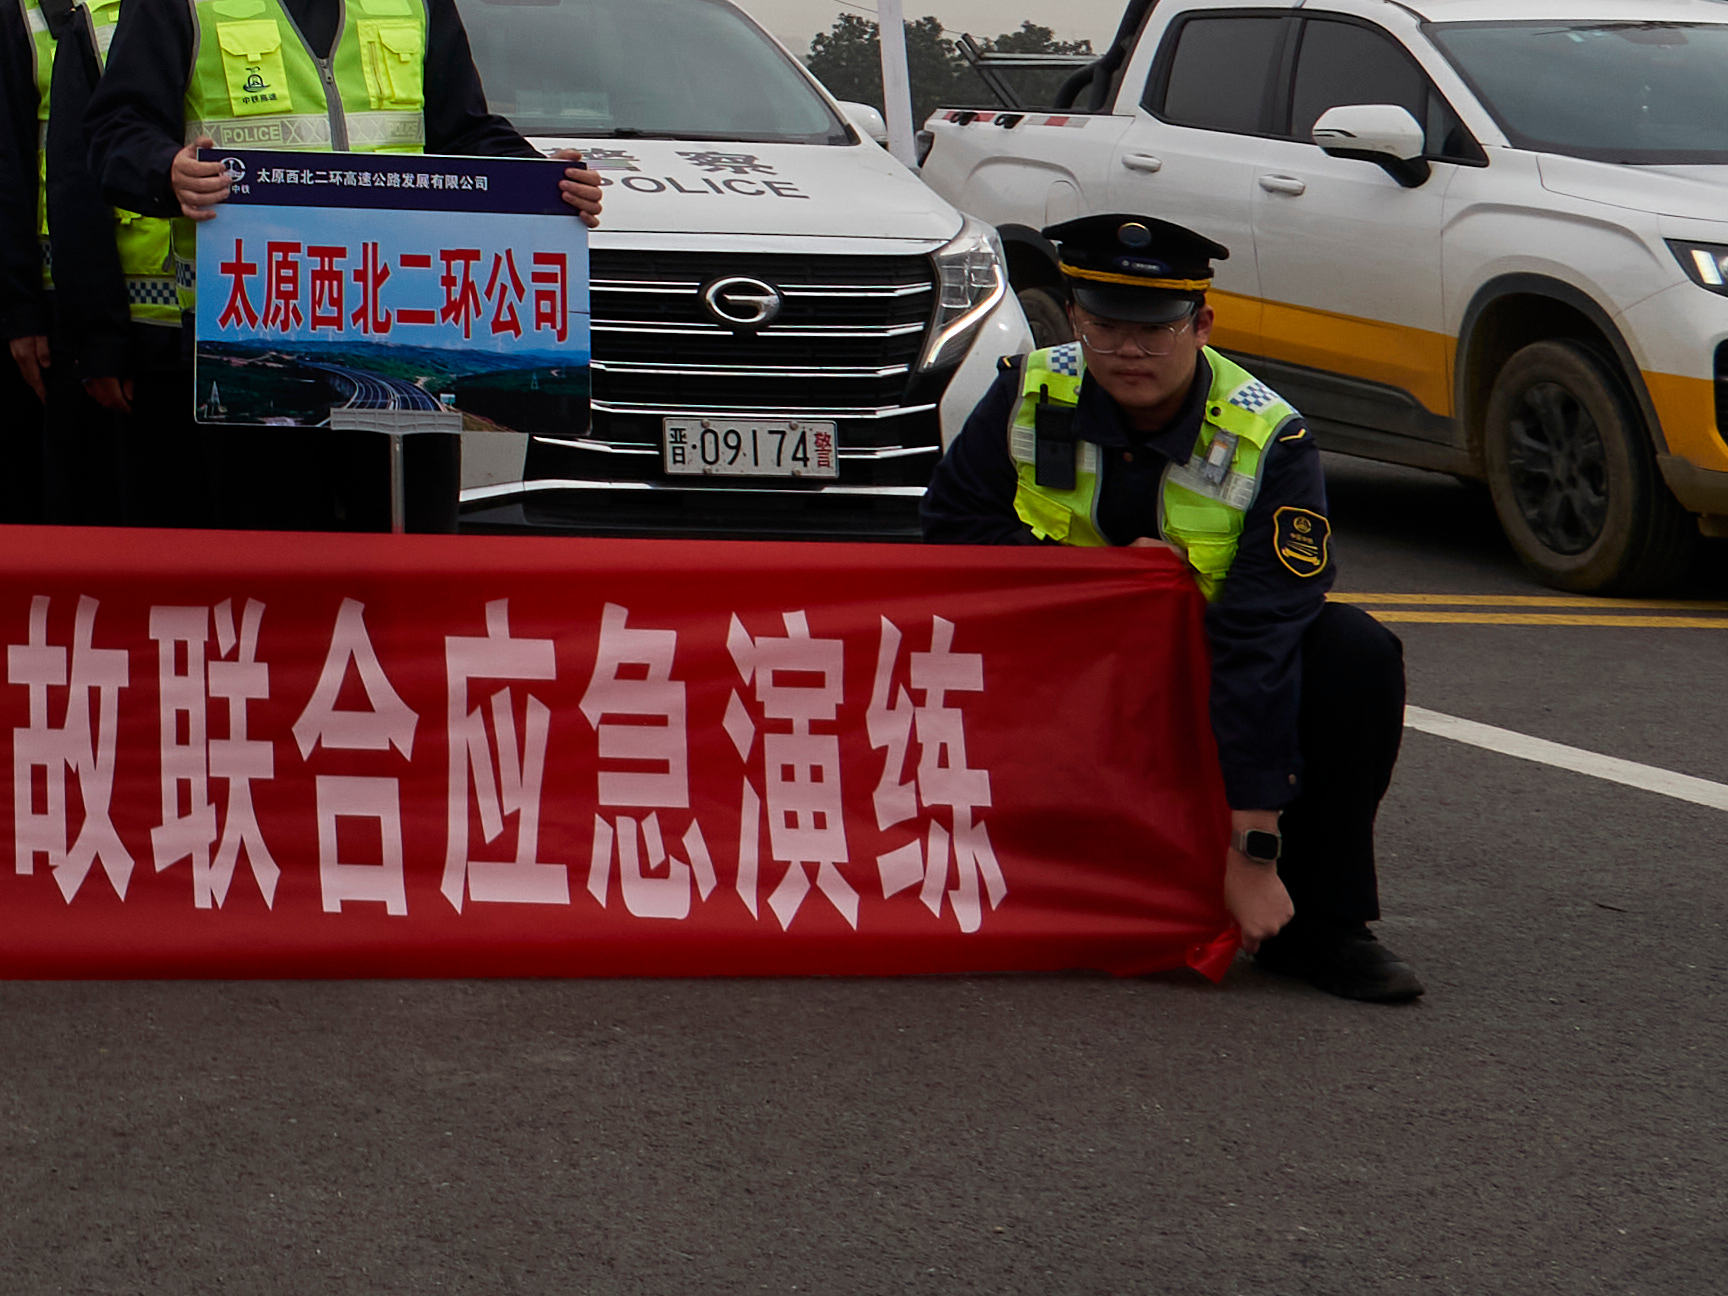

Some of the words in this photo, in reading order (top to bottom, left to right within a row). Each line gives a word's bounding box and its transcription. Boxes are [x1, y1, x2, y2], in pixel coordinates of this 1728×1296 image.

[223, 125, 281, 144] POLICE
[600, 175, 811, 200] OLICE
[217, 238, 569, 343] 太原西北二环公司
